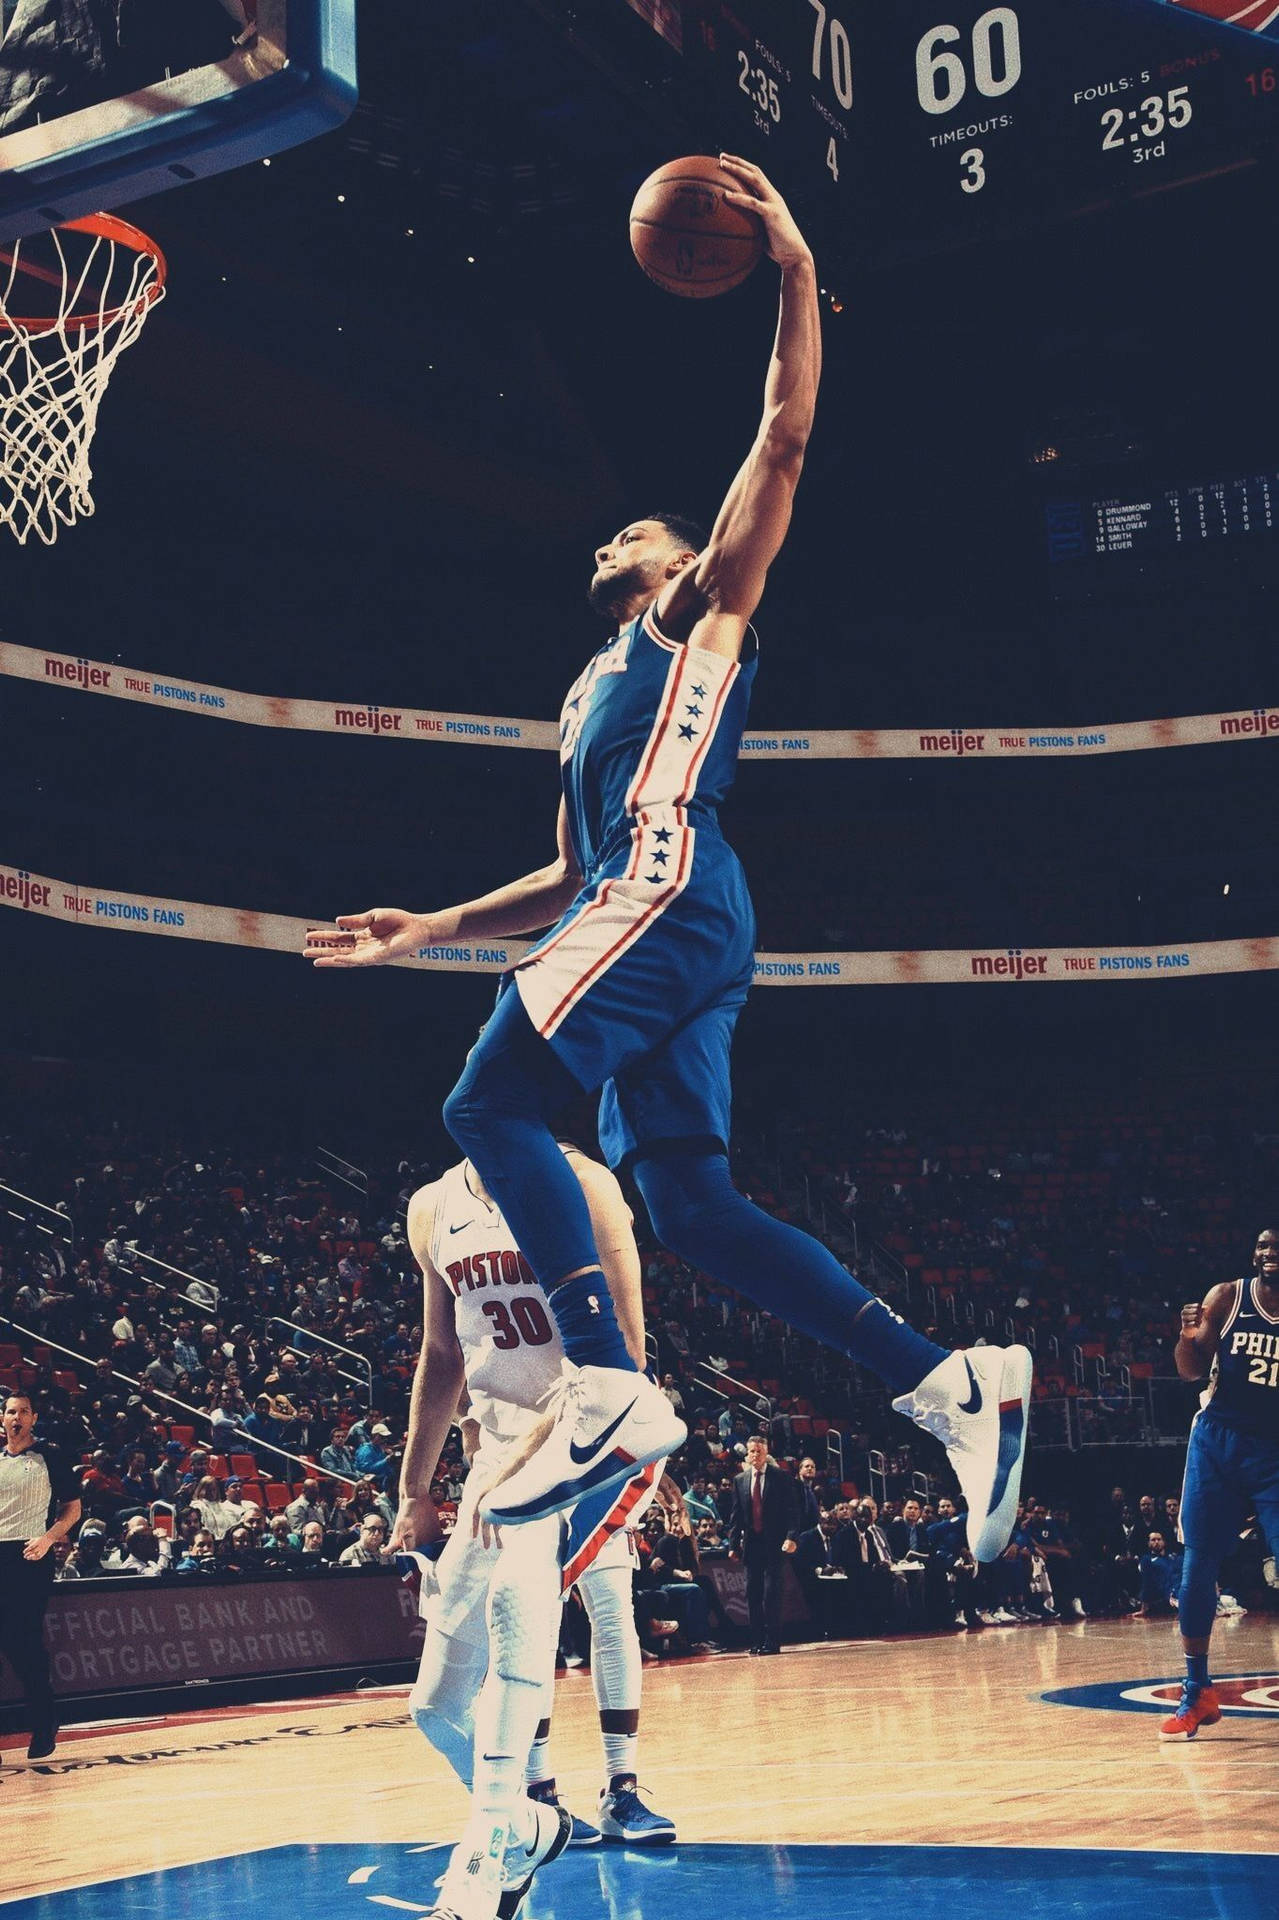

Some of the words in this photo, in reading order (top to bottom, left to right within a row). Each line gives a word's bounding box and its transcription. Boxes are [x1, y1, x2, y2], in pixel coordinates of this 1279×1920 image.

[808, 0, 853, 110] 70
[916, 7, 1021, 114] 60
[738, 50, 781, 122] 2:35
[1073, 77, 1134, 104] FOULS:
[1140, 70, 1150, 84] 5
[1245, 67, 1276, 96] 16
[754, 110, 770, 136] 3rd
[930, 115, 1013, 148] TIMEOUTS:
[1100, 85, 1193, 151] 2:35
[826, 136, 839, 182] 4
[1132, 141, 1166, 163] 3rd
[960, 148, 986, 193] 3
[1105, 502, 1152, 516] DRUMMOND
[1106, 513, 1142, 524] KENNARD
[1107, 520, 1148, 533] GALLOWAY
[1108, 532, 1133, 542] SMITH
[1108, 541, 1133, 551] LEUER
[45, 658, 111, 688] meijer
[124, 677, 150, 693] TRUE
[153, 684, 196, 703] PISTONS
[199, 694, 225, 709] FANS
[335, 706, 402, 734] meijer
[415, 719, 443, 732] TRUE
[446, 721, 490, 736] PISTONS
[494, 726, 521, 738] FANS
[782, 739, 810, 750] FANS
[920, 729, 985, 755] meijer
[999, 737, 1025, 748] TRUE
[1029, 735, 1075, 747] PISTONS
[1077, 734, 1106, 746] FANS
[63, 894, 92, 913] TRUE
[96, 901, 149, 921] PISTONS
[153, 909, 185, 926] FANS
[420, 947, 471, 961] PISTONS
[476, 949, 507, 963] FANS
[755, 962, 804, 975] PISTONS
[809, 962, 840, 975] FANS
[971, 950, 1048, 979] meijer
[1063, 957, 1095, 970] TRUE
[1100, 956, 1152, 970] PISTONS
[1156, 954, 1190, 967] FANS
[481, 1296, 553, 1351] 30
[1248, 1358, 1279, 1387] 21
[175, 1599, 254, 1632] BANK
[263, 1595, 316, 1625] AND
[51, 1640, 201, 1683] ORTGAGE
[208, 1630, 330, 1666] PARTNER
